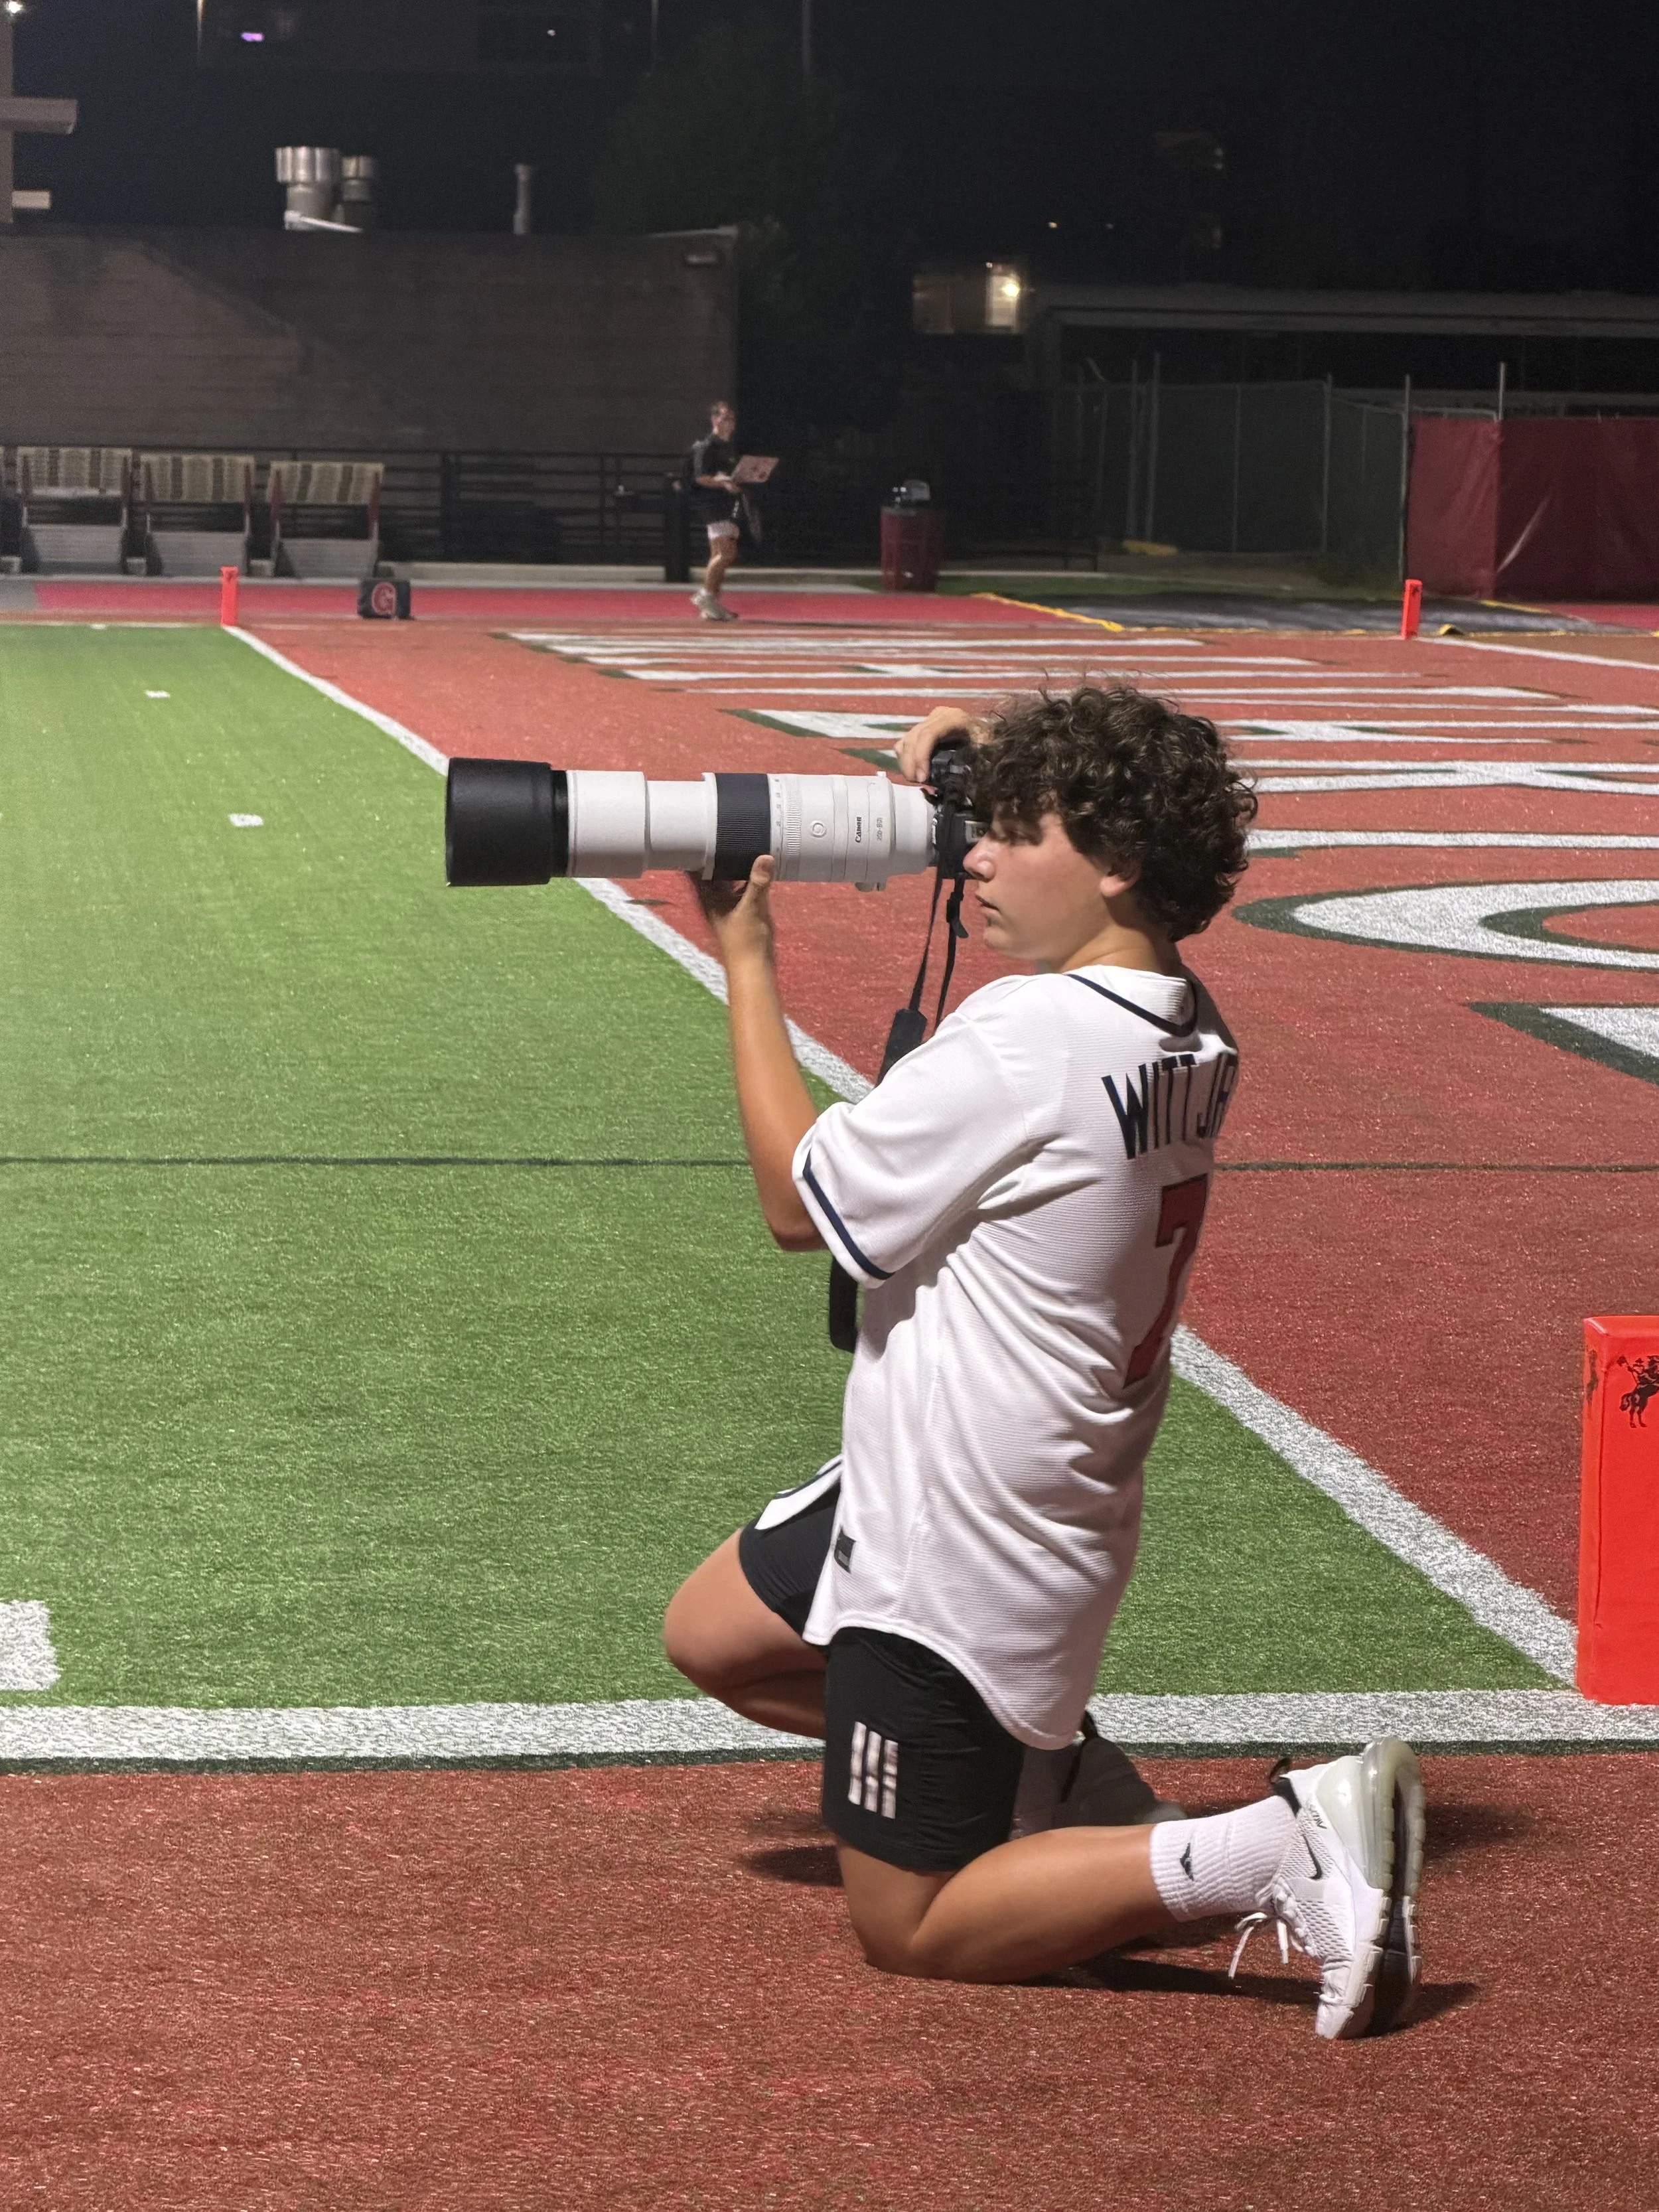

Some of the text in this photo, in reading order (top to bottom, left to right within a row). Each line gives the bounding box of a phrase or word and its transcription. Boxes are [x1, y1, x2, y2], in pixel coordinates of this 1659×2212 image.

[371, 581, 397, 615] G
[854, 816, 863, 844] Canon
[1101, 1054, 1196, 1159] WITT
[1123, 1173, 1208, 1390] 7
